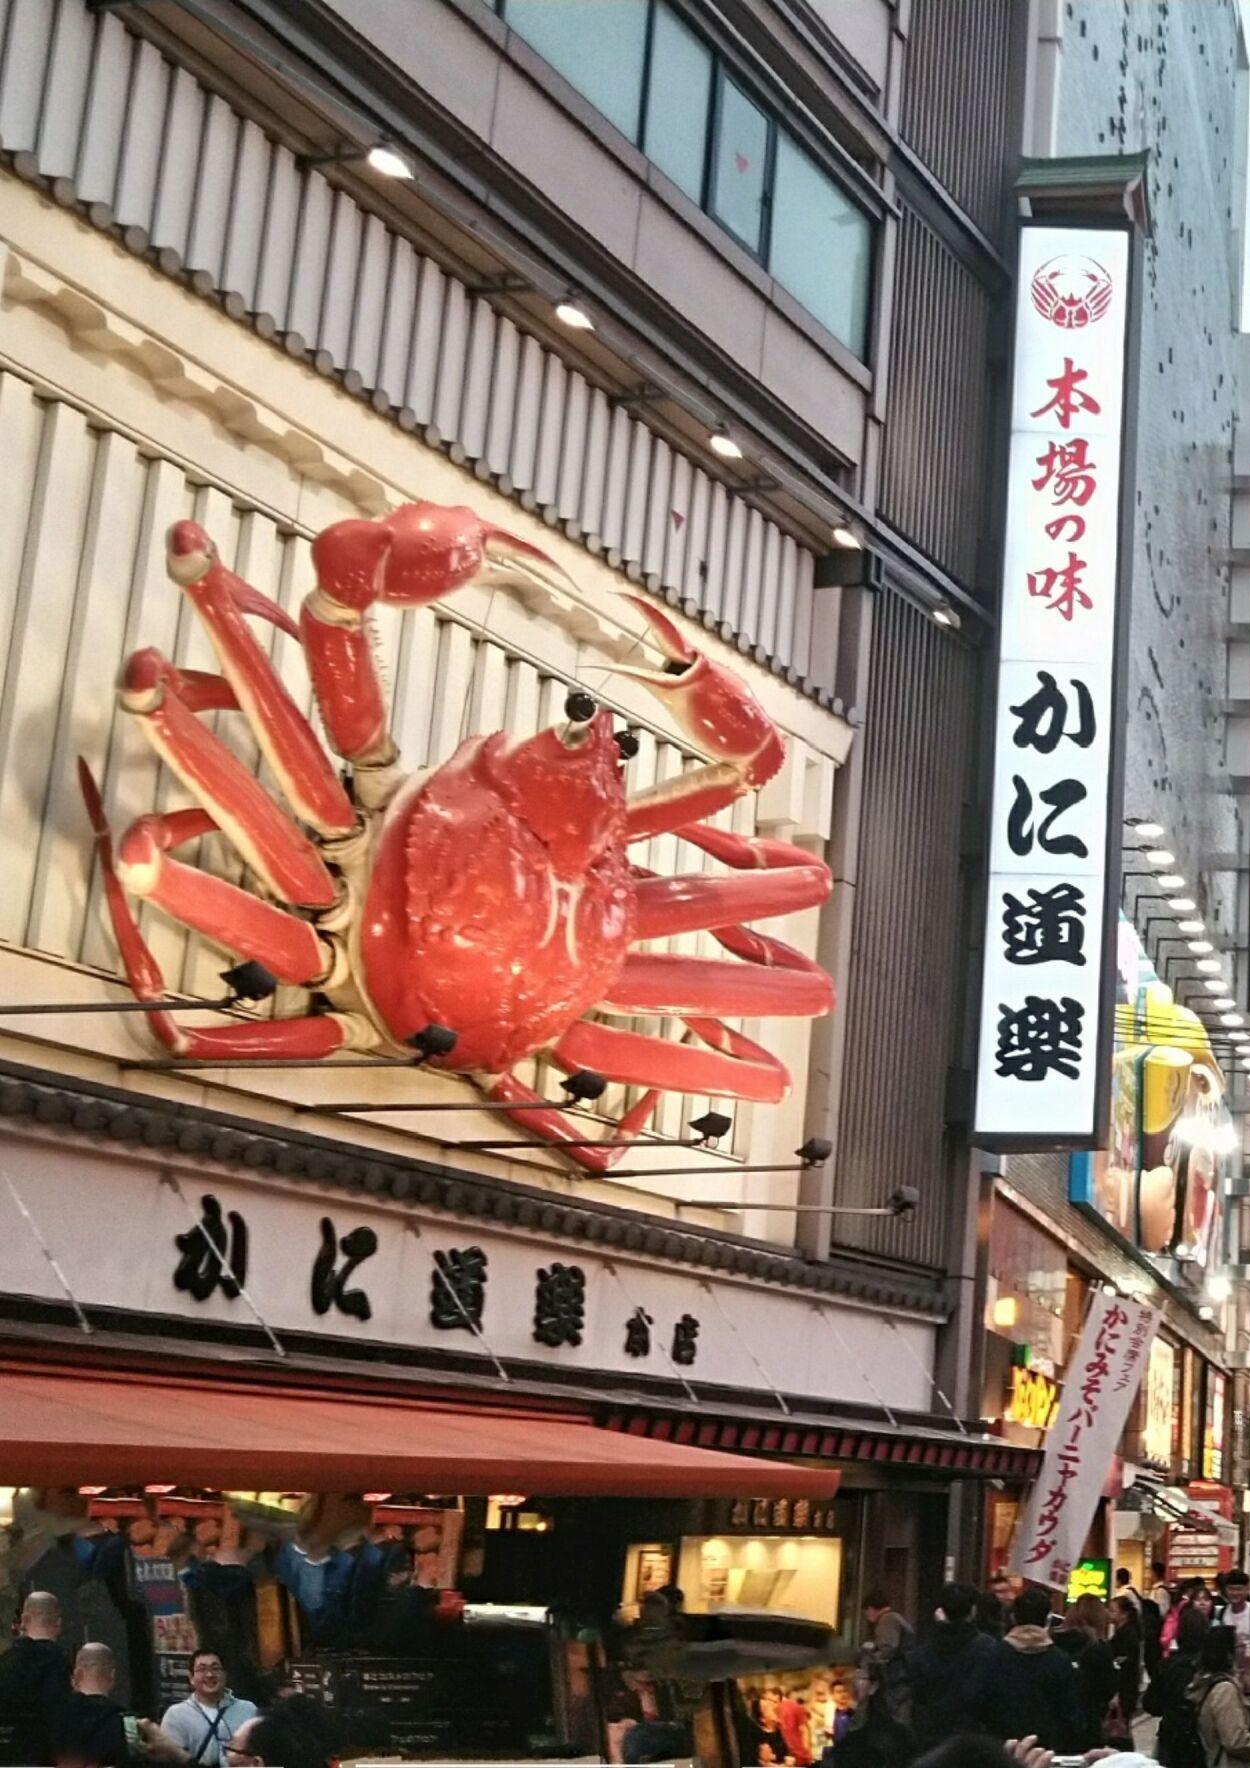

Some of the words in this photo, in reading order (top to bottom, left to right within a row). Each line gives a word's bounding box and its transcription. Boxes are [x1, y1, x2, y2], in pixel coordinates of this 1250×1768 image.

[1026, 357, 1101, 621] 本場の味
[995, 670, 1097, 1081] かに道楽
[1024, 1303, 1129, 1564] かにみそバーニャカウダ
